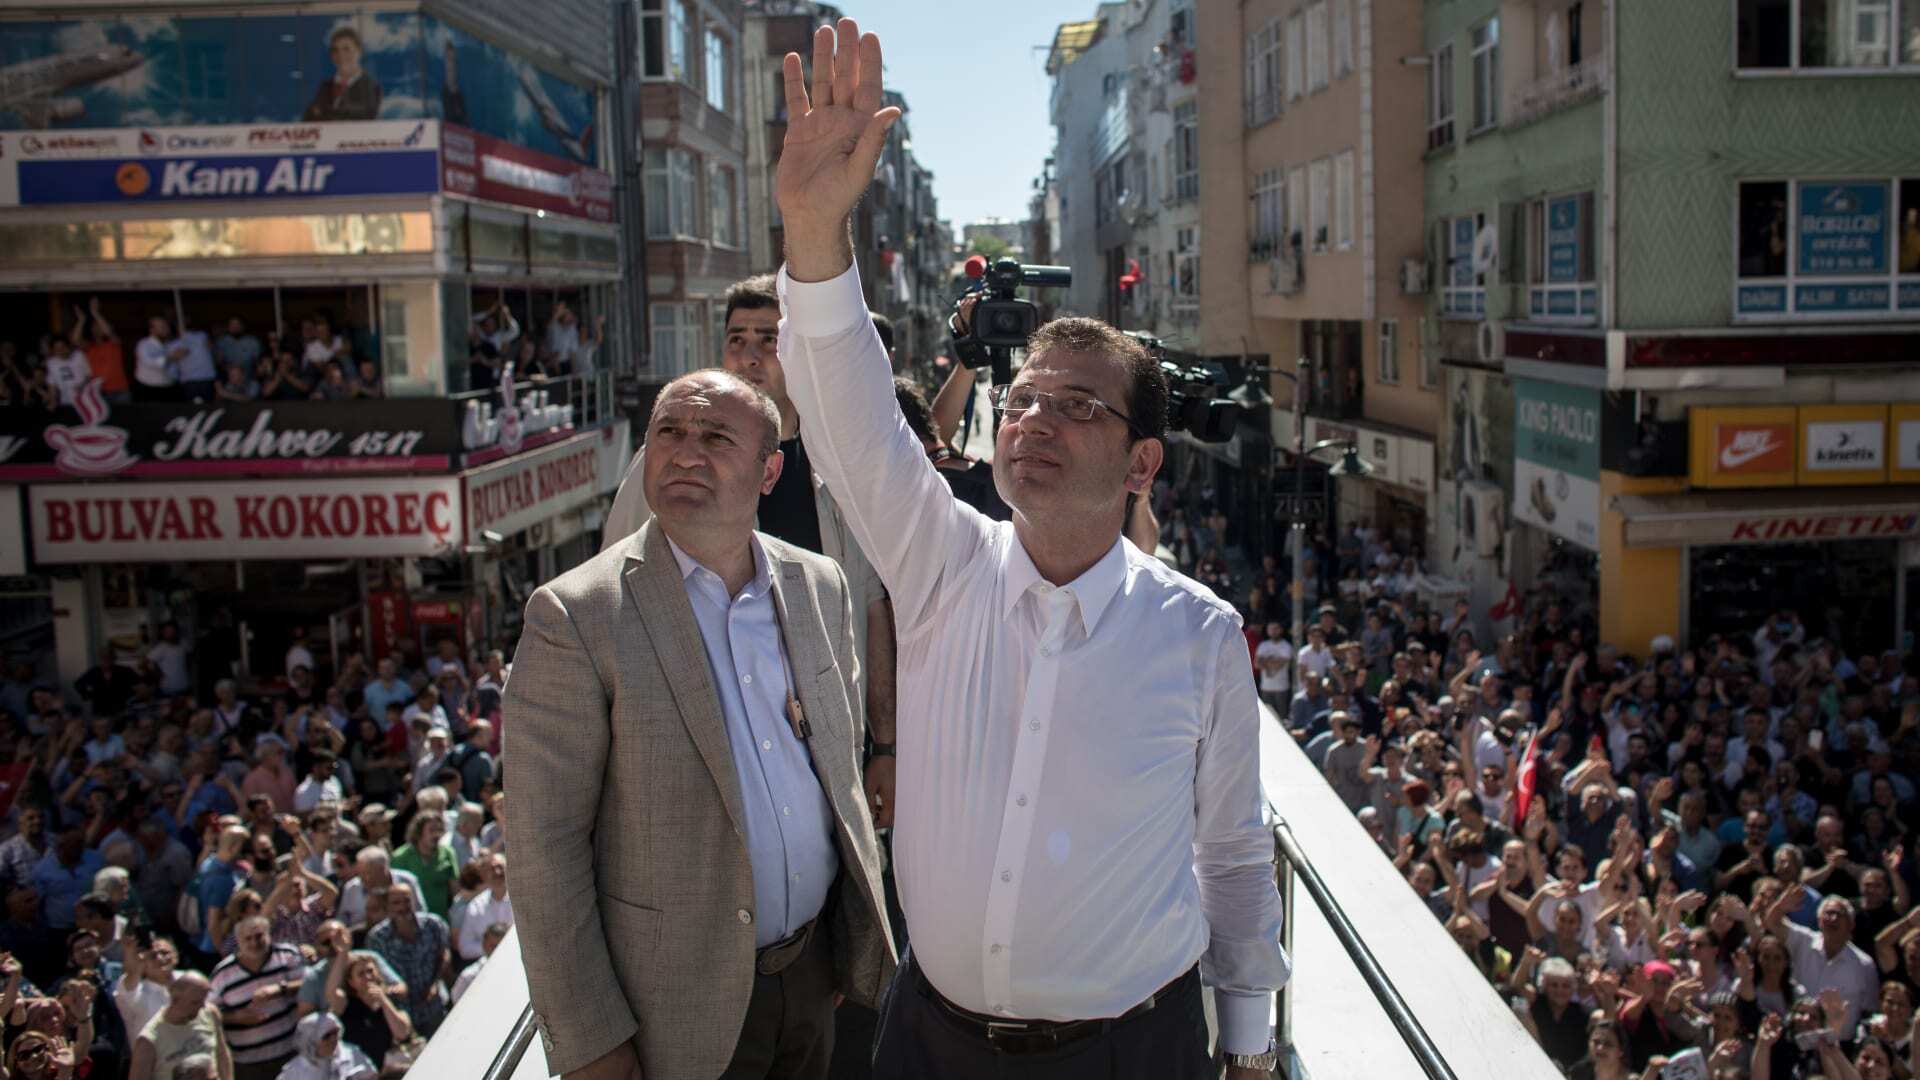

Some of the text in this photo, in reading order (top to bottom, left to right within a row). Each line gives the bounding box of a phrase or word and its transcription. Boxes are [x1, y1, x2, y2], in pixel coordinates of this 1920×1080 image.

[248, 127, 321, 143] PEGASUS
[161, 157, 335, 196] Kam Air
[152, 408, 423, 460] Kahve 1517
[1519, 397, 1597, 444] KING PAOLO
[1815, 446, 1876, 462] kinetix
[44, 490, 451, 545] BULVAR KOKOREÇ
[472, 468, 536, 529] BULVAR
[1731, 512, 1913, 540] KINETIX
